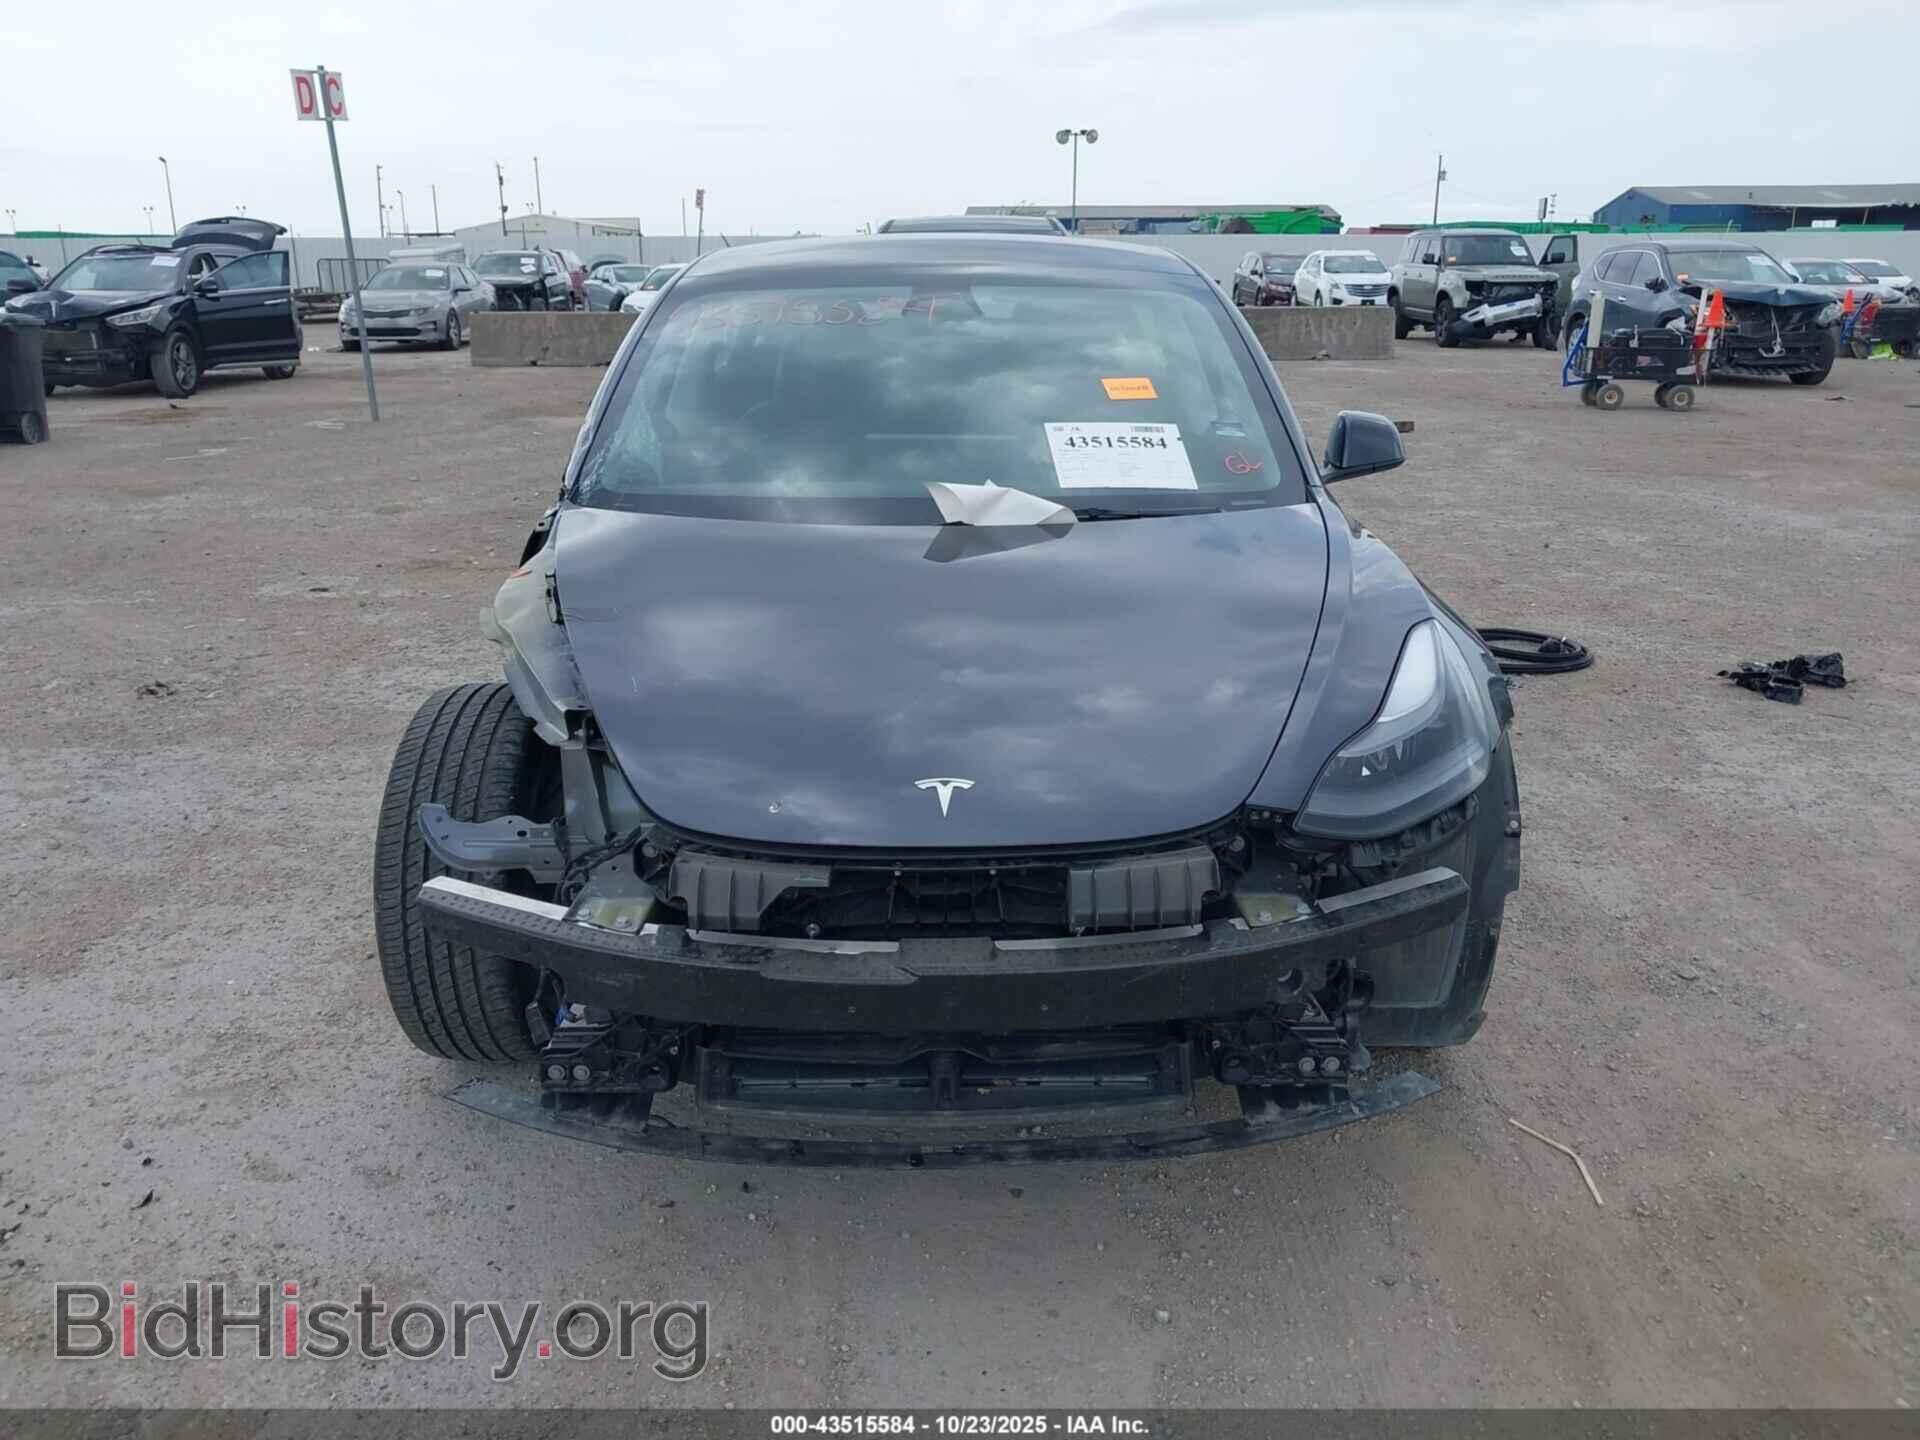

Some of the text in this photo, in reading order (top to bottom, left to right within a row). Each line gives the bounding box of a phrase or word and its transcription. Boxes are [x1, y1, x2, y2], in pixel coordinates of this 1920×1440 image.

[295, 76, 313, 114] D
[327, 77, 343, 115] C
[1064, 436, 1167, 449] 43515584
